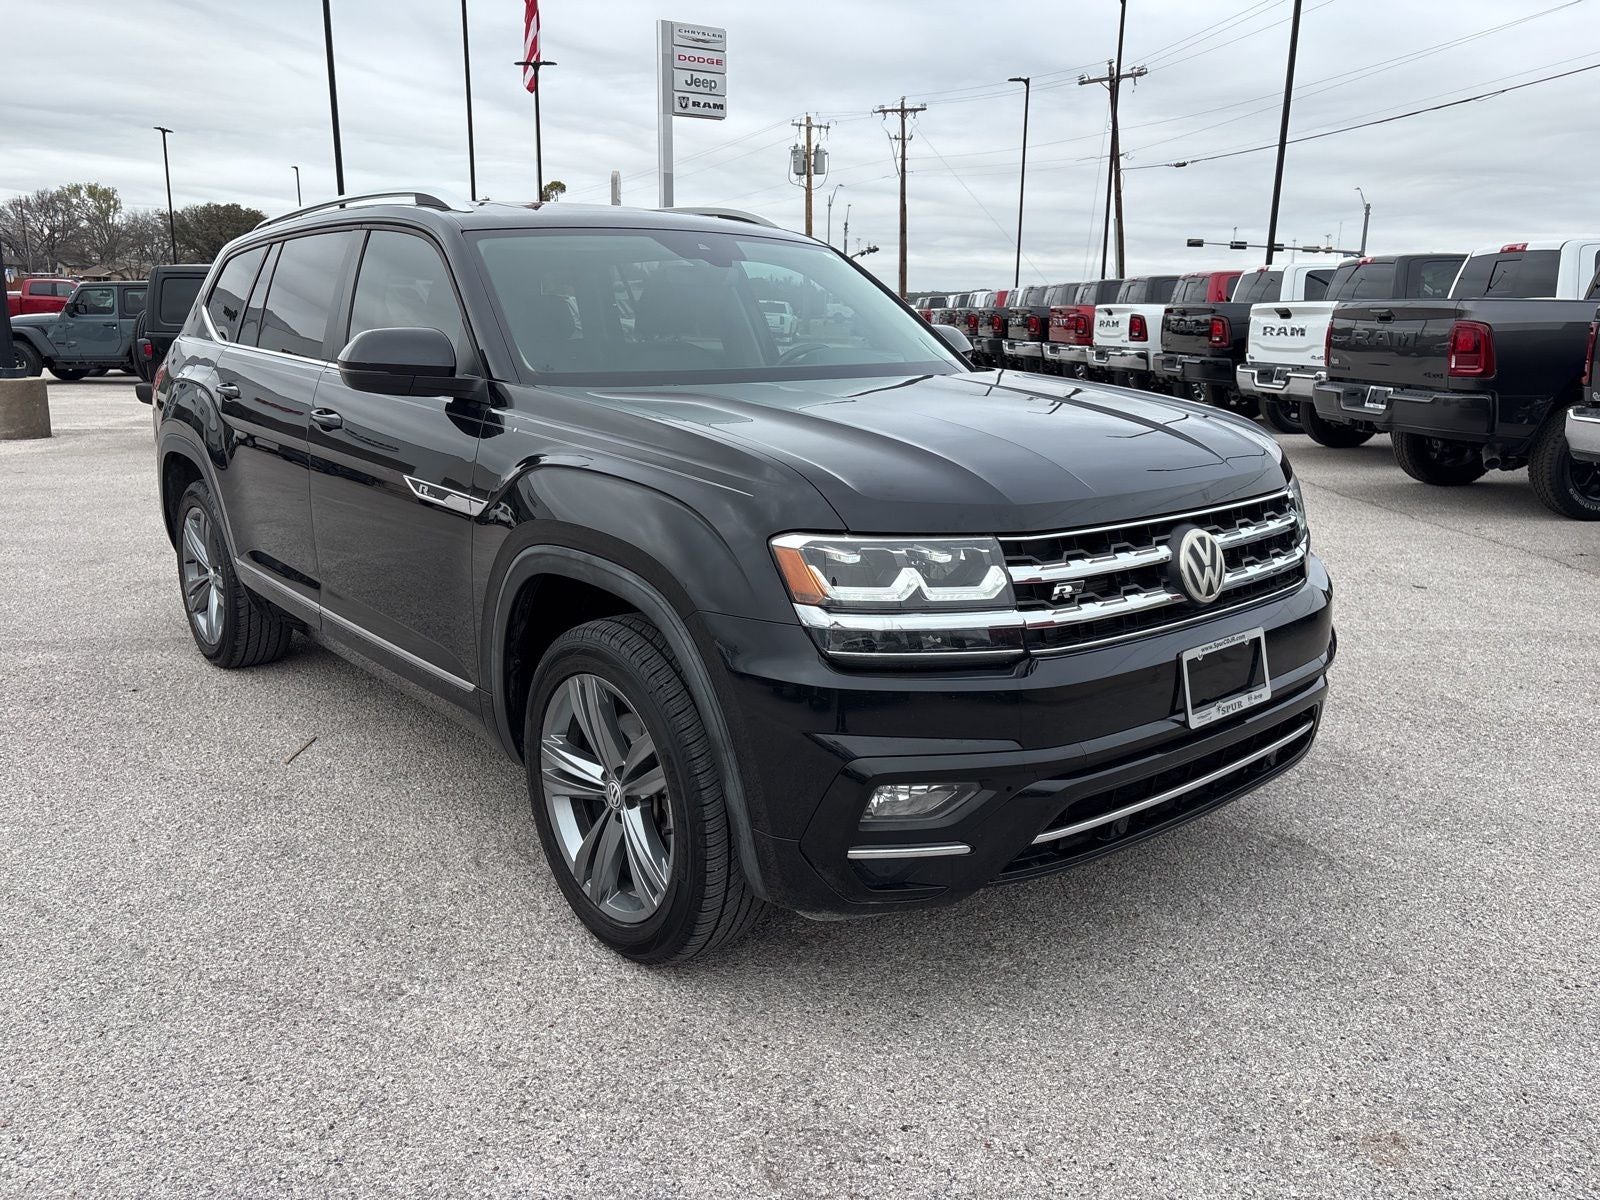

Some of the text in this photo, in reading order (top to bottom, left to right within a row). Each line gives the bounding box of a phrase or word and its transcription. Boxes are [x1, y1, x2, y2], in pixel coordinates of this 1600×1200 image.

[678, 28, 722, 38] CHRYSLER
[677, 54, 724, 66] DODGE
[684, 73, 717, 91] Jeep
[691, 100, 724, 110] RAM
[1099, 320, 1119, 328] RAM
[1262, 325, 1307, 337] RAM
[1351, 329, 1418, 347] RAM
[1221, 701, 1243, 715] SPUR
